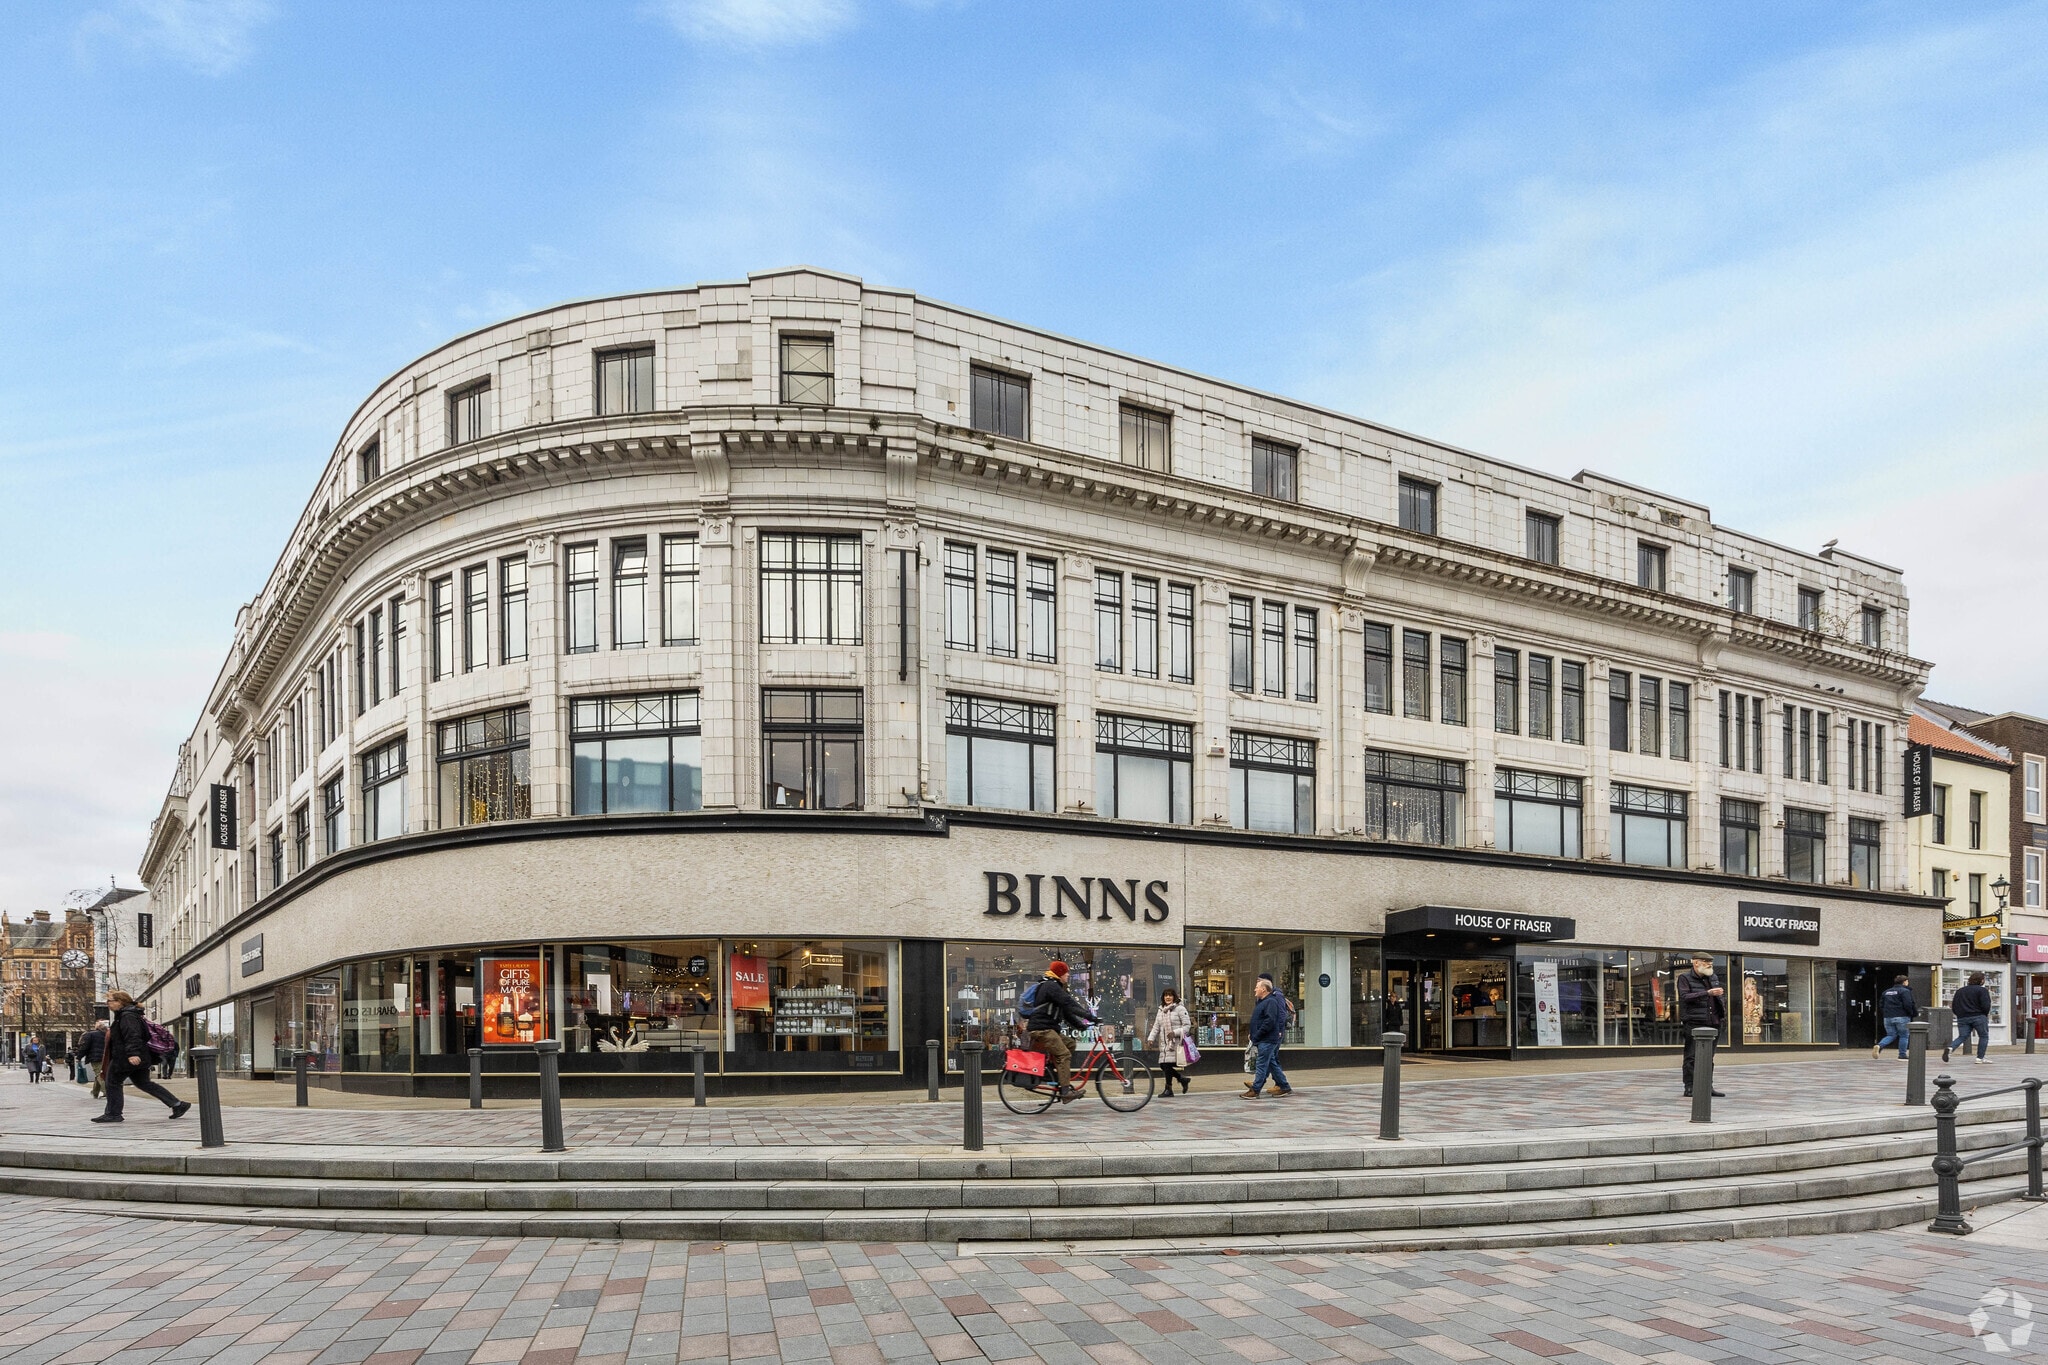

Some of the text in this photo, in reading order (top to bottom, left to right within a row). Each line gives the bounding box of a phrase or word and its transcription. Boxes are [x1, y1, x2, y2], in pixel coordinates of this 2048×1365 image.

[1913, 751, 1921, 812] HOUSE OF FRASER
[220, 789, 228, 845] HOUSE OF FRASER
[983, 871, 1170, 923] BINNS
[1455, 914, 1552, 933] HOUSE OF FRASER
[1743, 915, 1818, 931] HOUSE OF FRASER
[1943, 919, 1973, 928] chanics'
[500, 968, 530, 979] GIFTS
[735, 971, 766, 983] SALE
[500, 986, 530, 994] MAGIC
